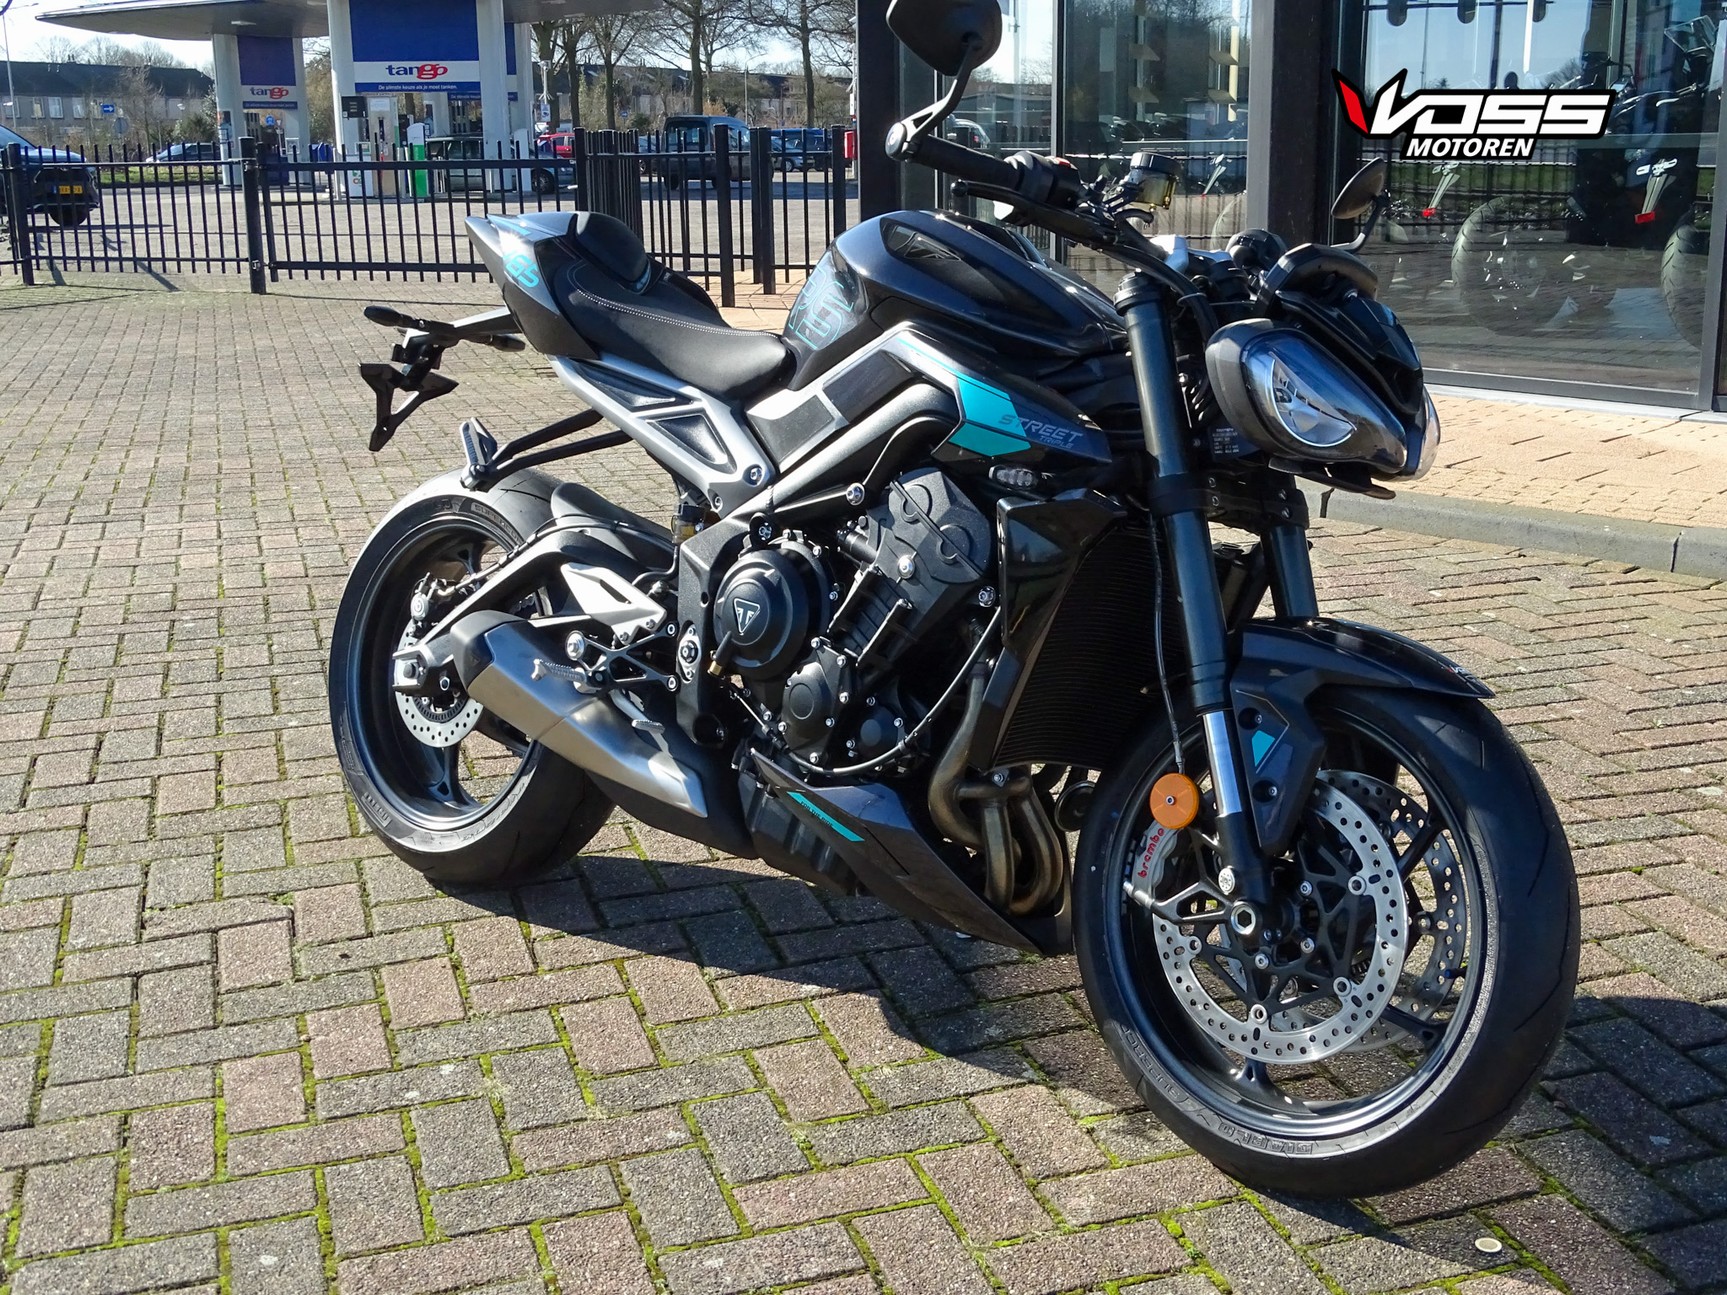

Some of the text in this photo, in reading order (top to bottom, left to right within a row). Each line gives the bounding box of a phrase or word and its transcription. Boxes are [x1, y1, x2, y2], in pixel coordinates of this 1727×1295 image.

[385, 64, 448, 80] tango
[250, 86, 289, 99] tango
[998, 414, 1083, 443] STREET
[1039, 435, 1074, 449] TRIPLE
[1138, 827, 1165, 878] brembo
